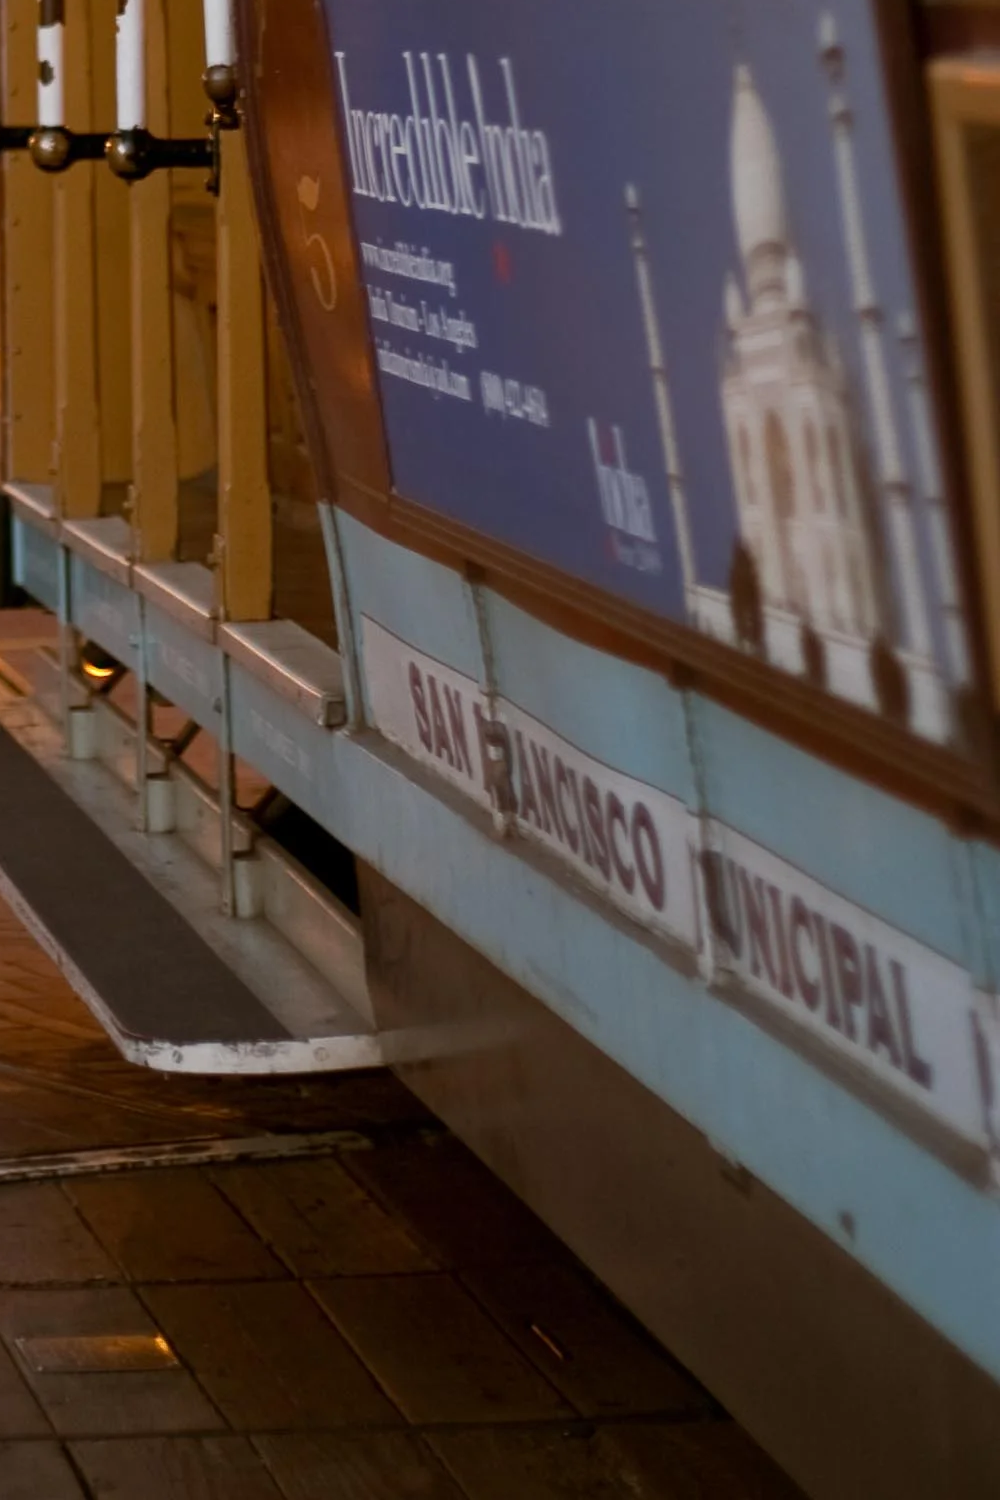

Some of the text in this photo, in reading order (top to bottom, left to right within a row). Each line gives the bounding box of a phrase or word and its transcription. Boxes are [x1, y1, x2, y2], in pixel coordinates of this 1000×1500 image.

[334, 51, 484, 220] Incredible
[409, 661, 474, 780] SAN
[473, 701, 665, 912] ANCISCO
